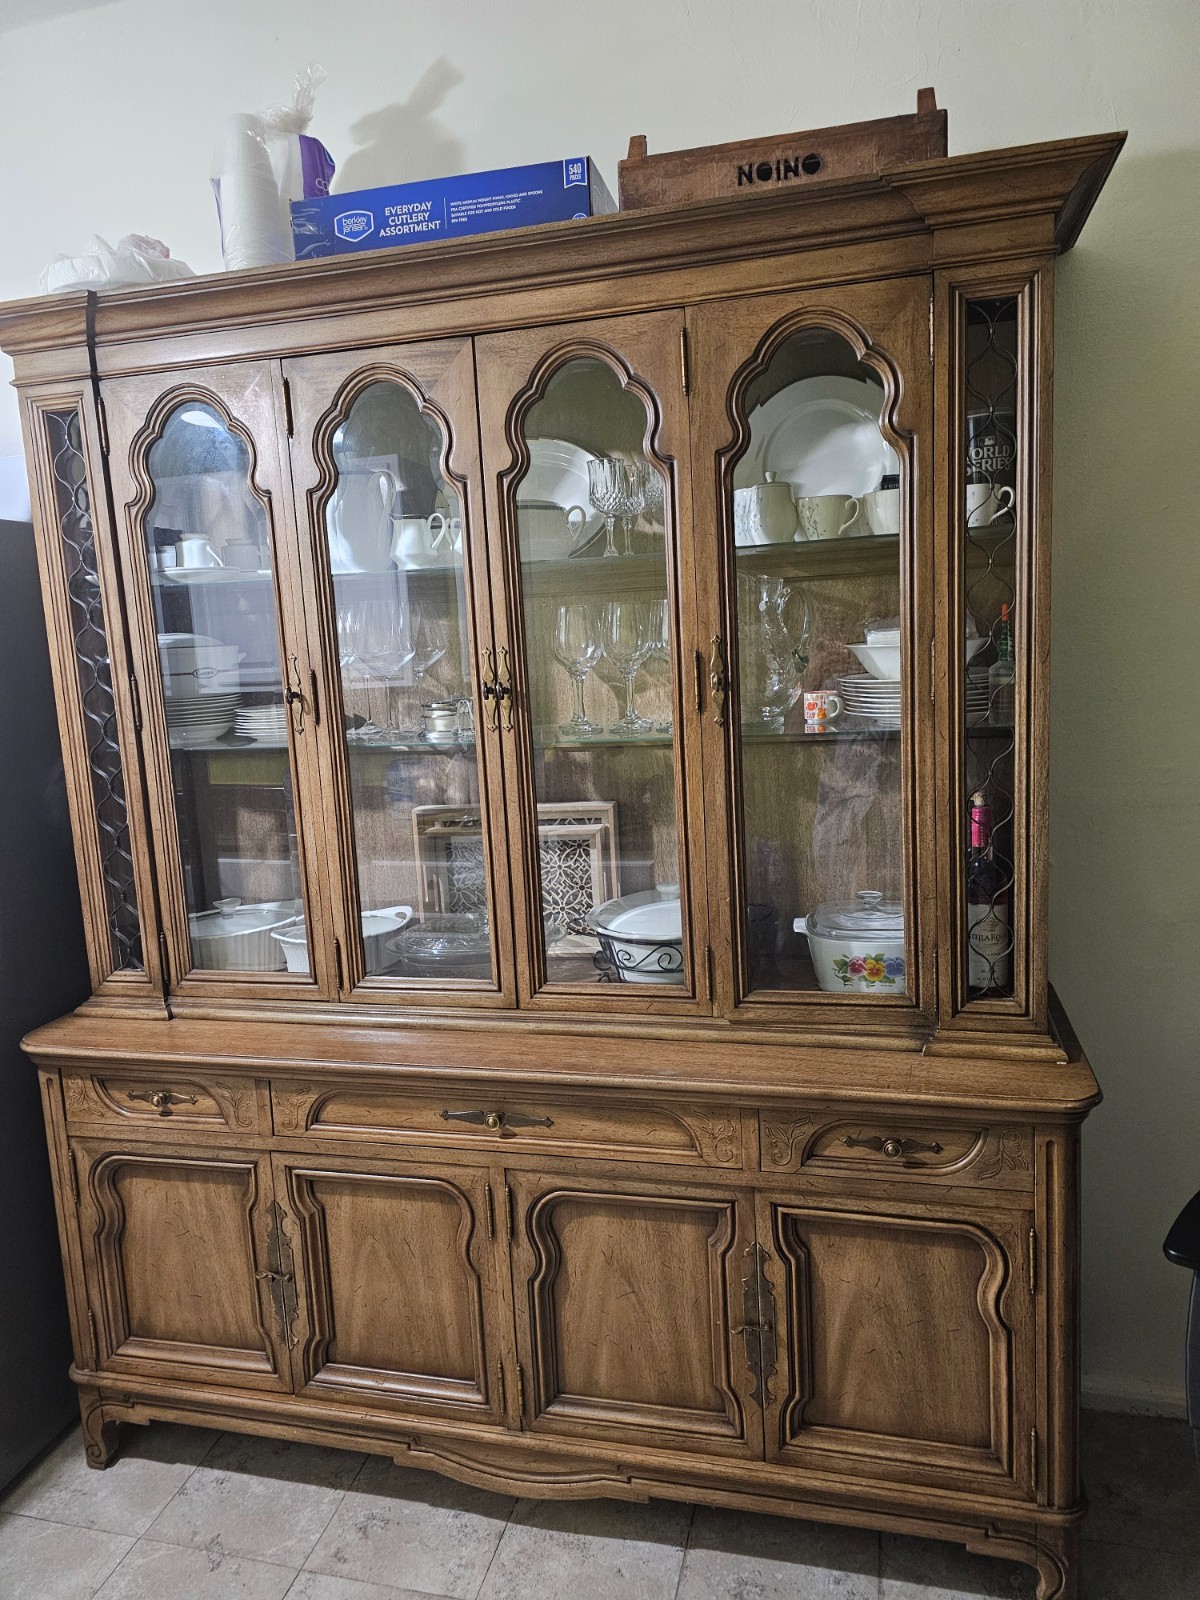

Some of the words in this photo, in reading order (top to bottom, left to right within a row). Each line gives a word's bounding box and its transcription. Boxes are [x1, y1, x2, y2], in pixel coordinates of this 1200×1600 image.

[568, 162, 582, 175] 540
[384, 201, 432, 216] EVERYDAY
[342, 215, 367, 226] berkley
[388, 212, 430, 226] CUTLERY
[379, 220, 441, 238] ASSORTMENT
